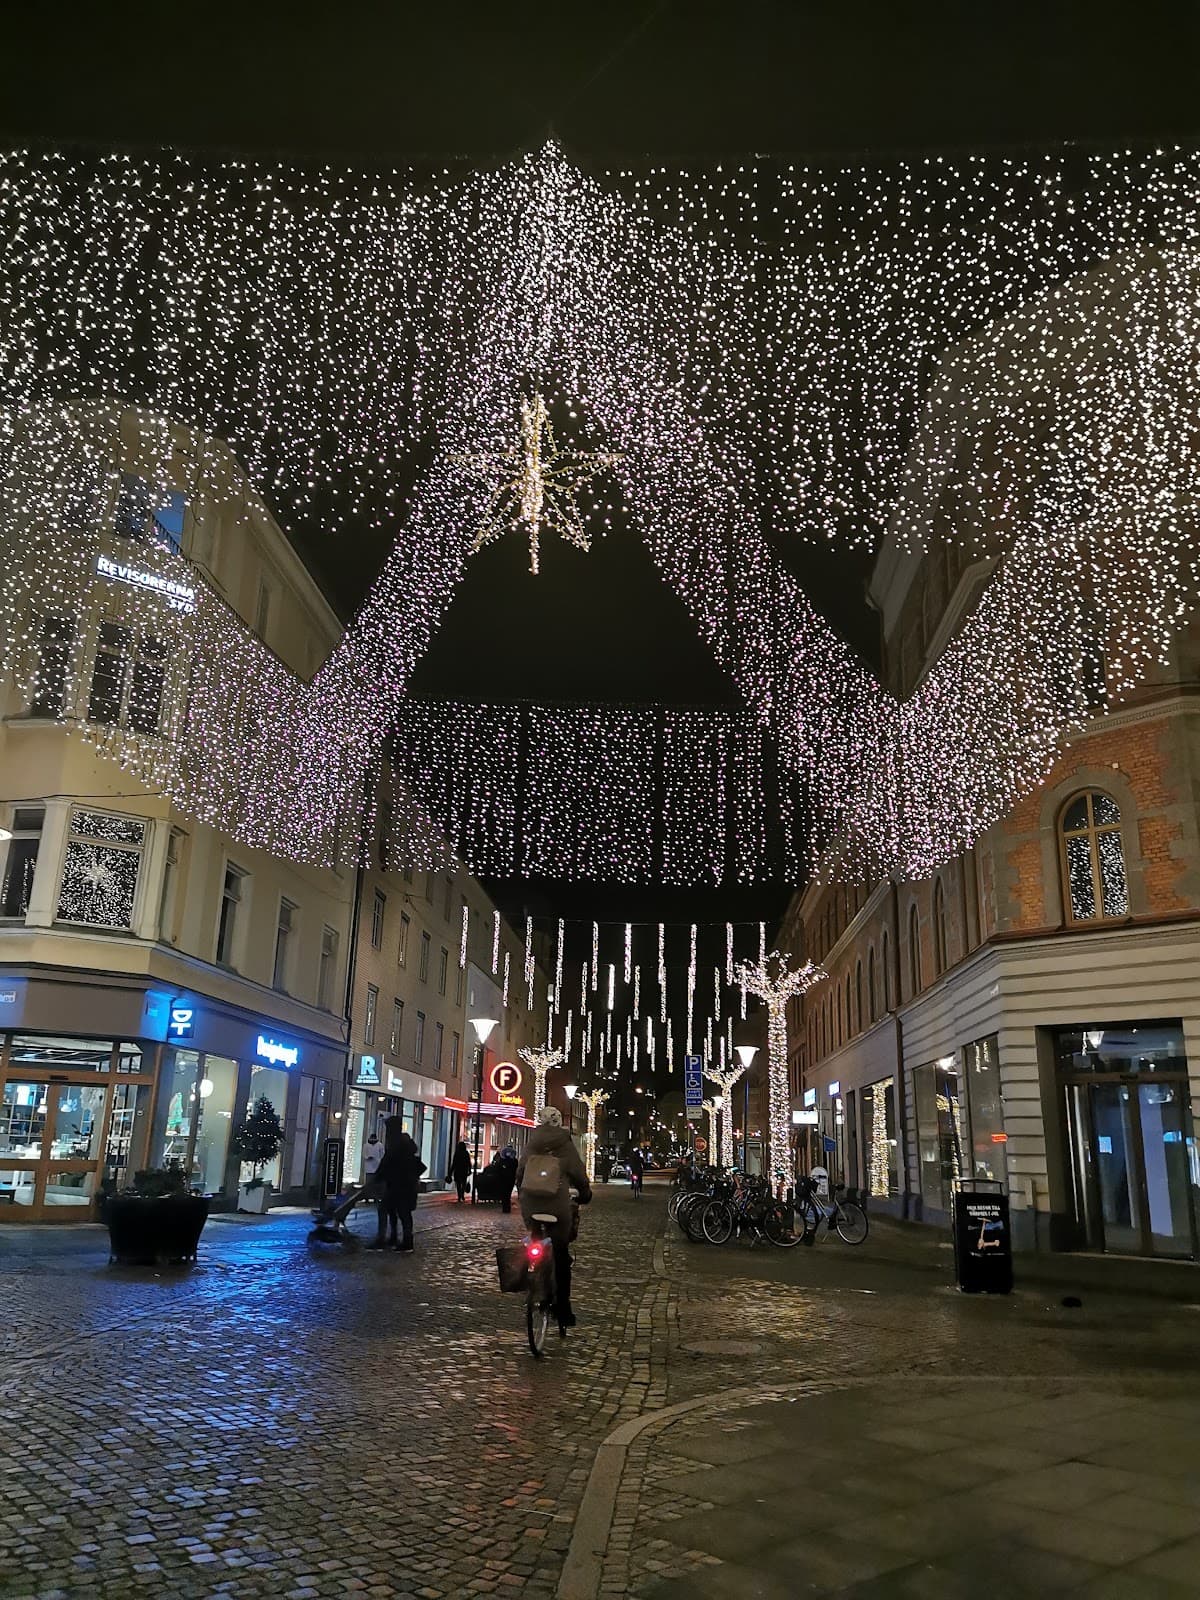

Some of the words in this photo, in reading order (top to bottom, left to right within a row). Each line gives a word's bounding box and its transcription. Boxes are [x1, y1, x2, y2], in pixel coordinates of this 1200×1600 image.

[97, 557, 195, 600] REVISORERNA
[169, 599, 194, 613] SYD
[361, 1055, 377, 1075] R
[689, 1057, 699, 1070] P
[500, 1069, 512, 1087] F
